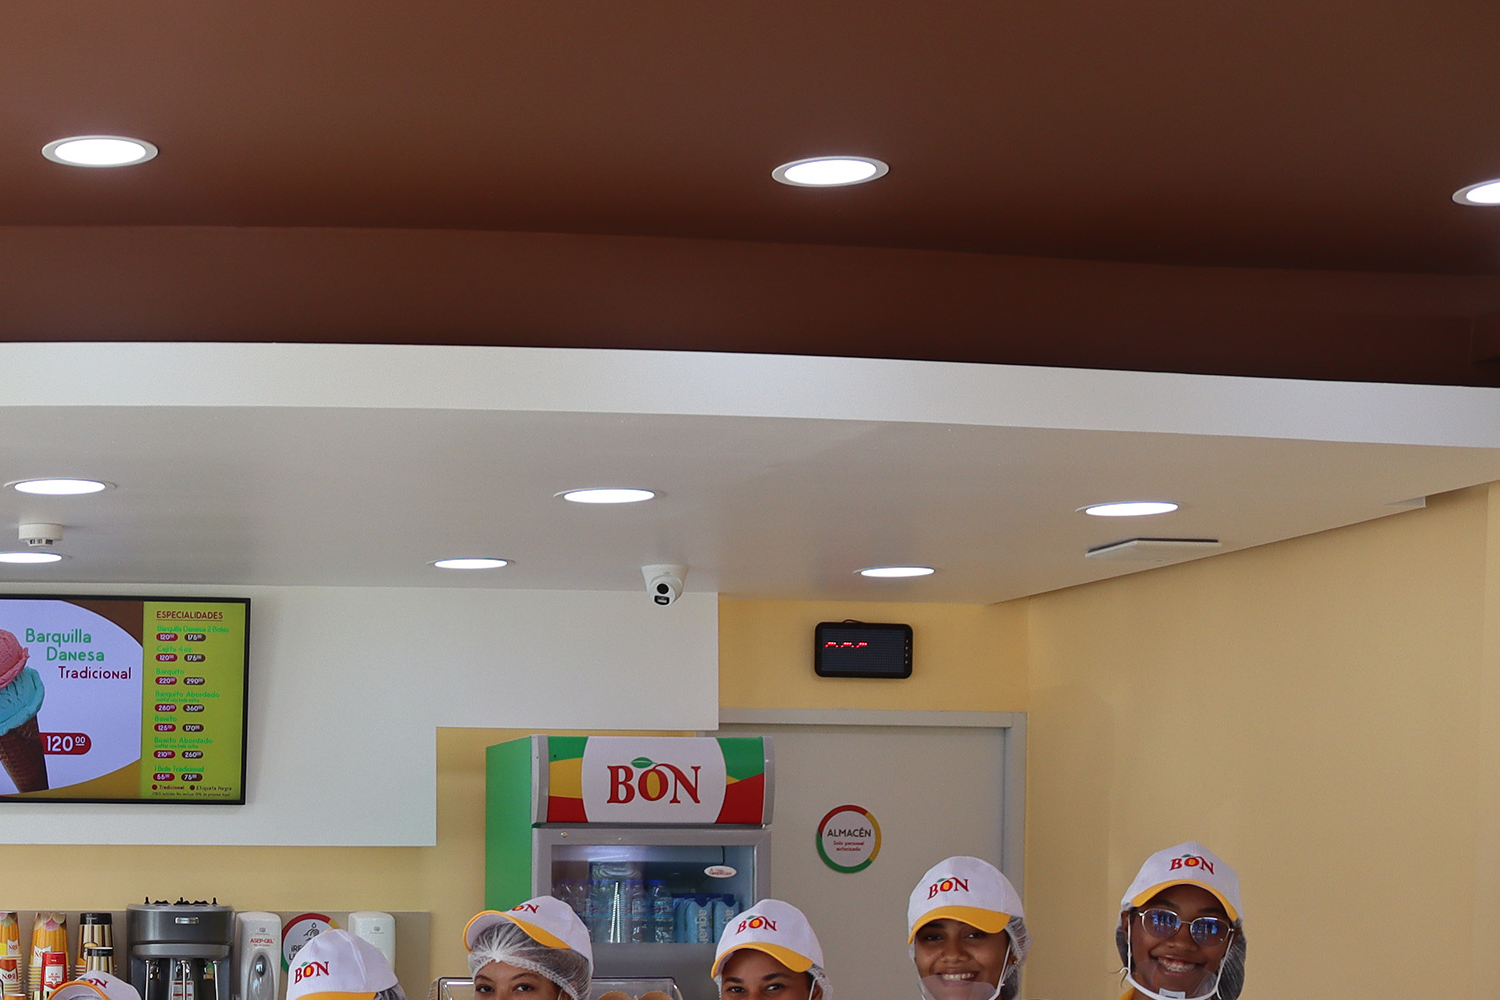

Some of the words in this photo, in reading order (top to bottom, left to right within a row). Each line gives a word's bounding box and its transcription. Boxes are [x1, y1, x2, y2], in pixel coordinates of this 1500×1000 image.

[156, 610, 224, 620] ESPECIALIDADES
[25, 627, 92, 647] Barquilla
[607, 760, 701, 804] BON
[827, 827, 872, 838] ALMACÉN
[1168, 856, 1215, 875] BON
[927, 877, 970, 900] BON
[511, 903, 540, 914] ON
[735, 916, 777, 935] BON
[294, 961, 330, 986] BON
